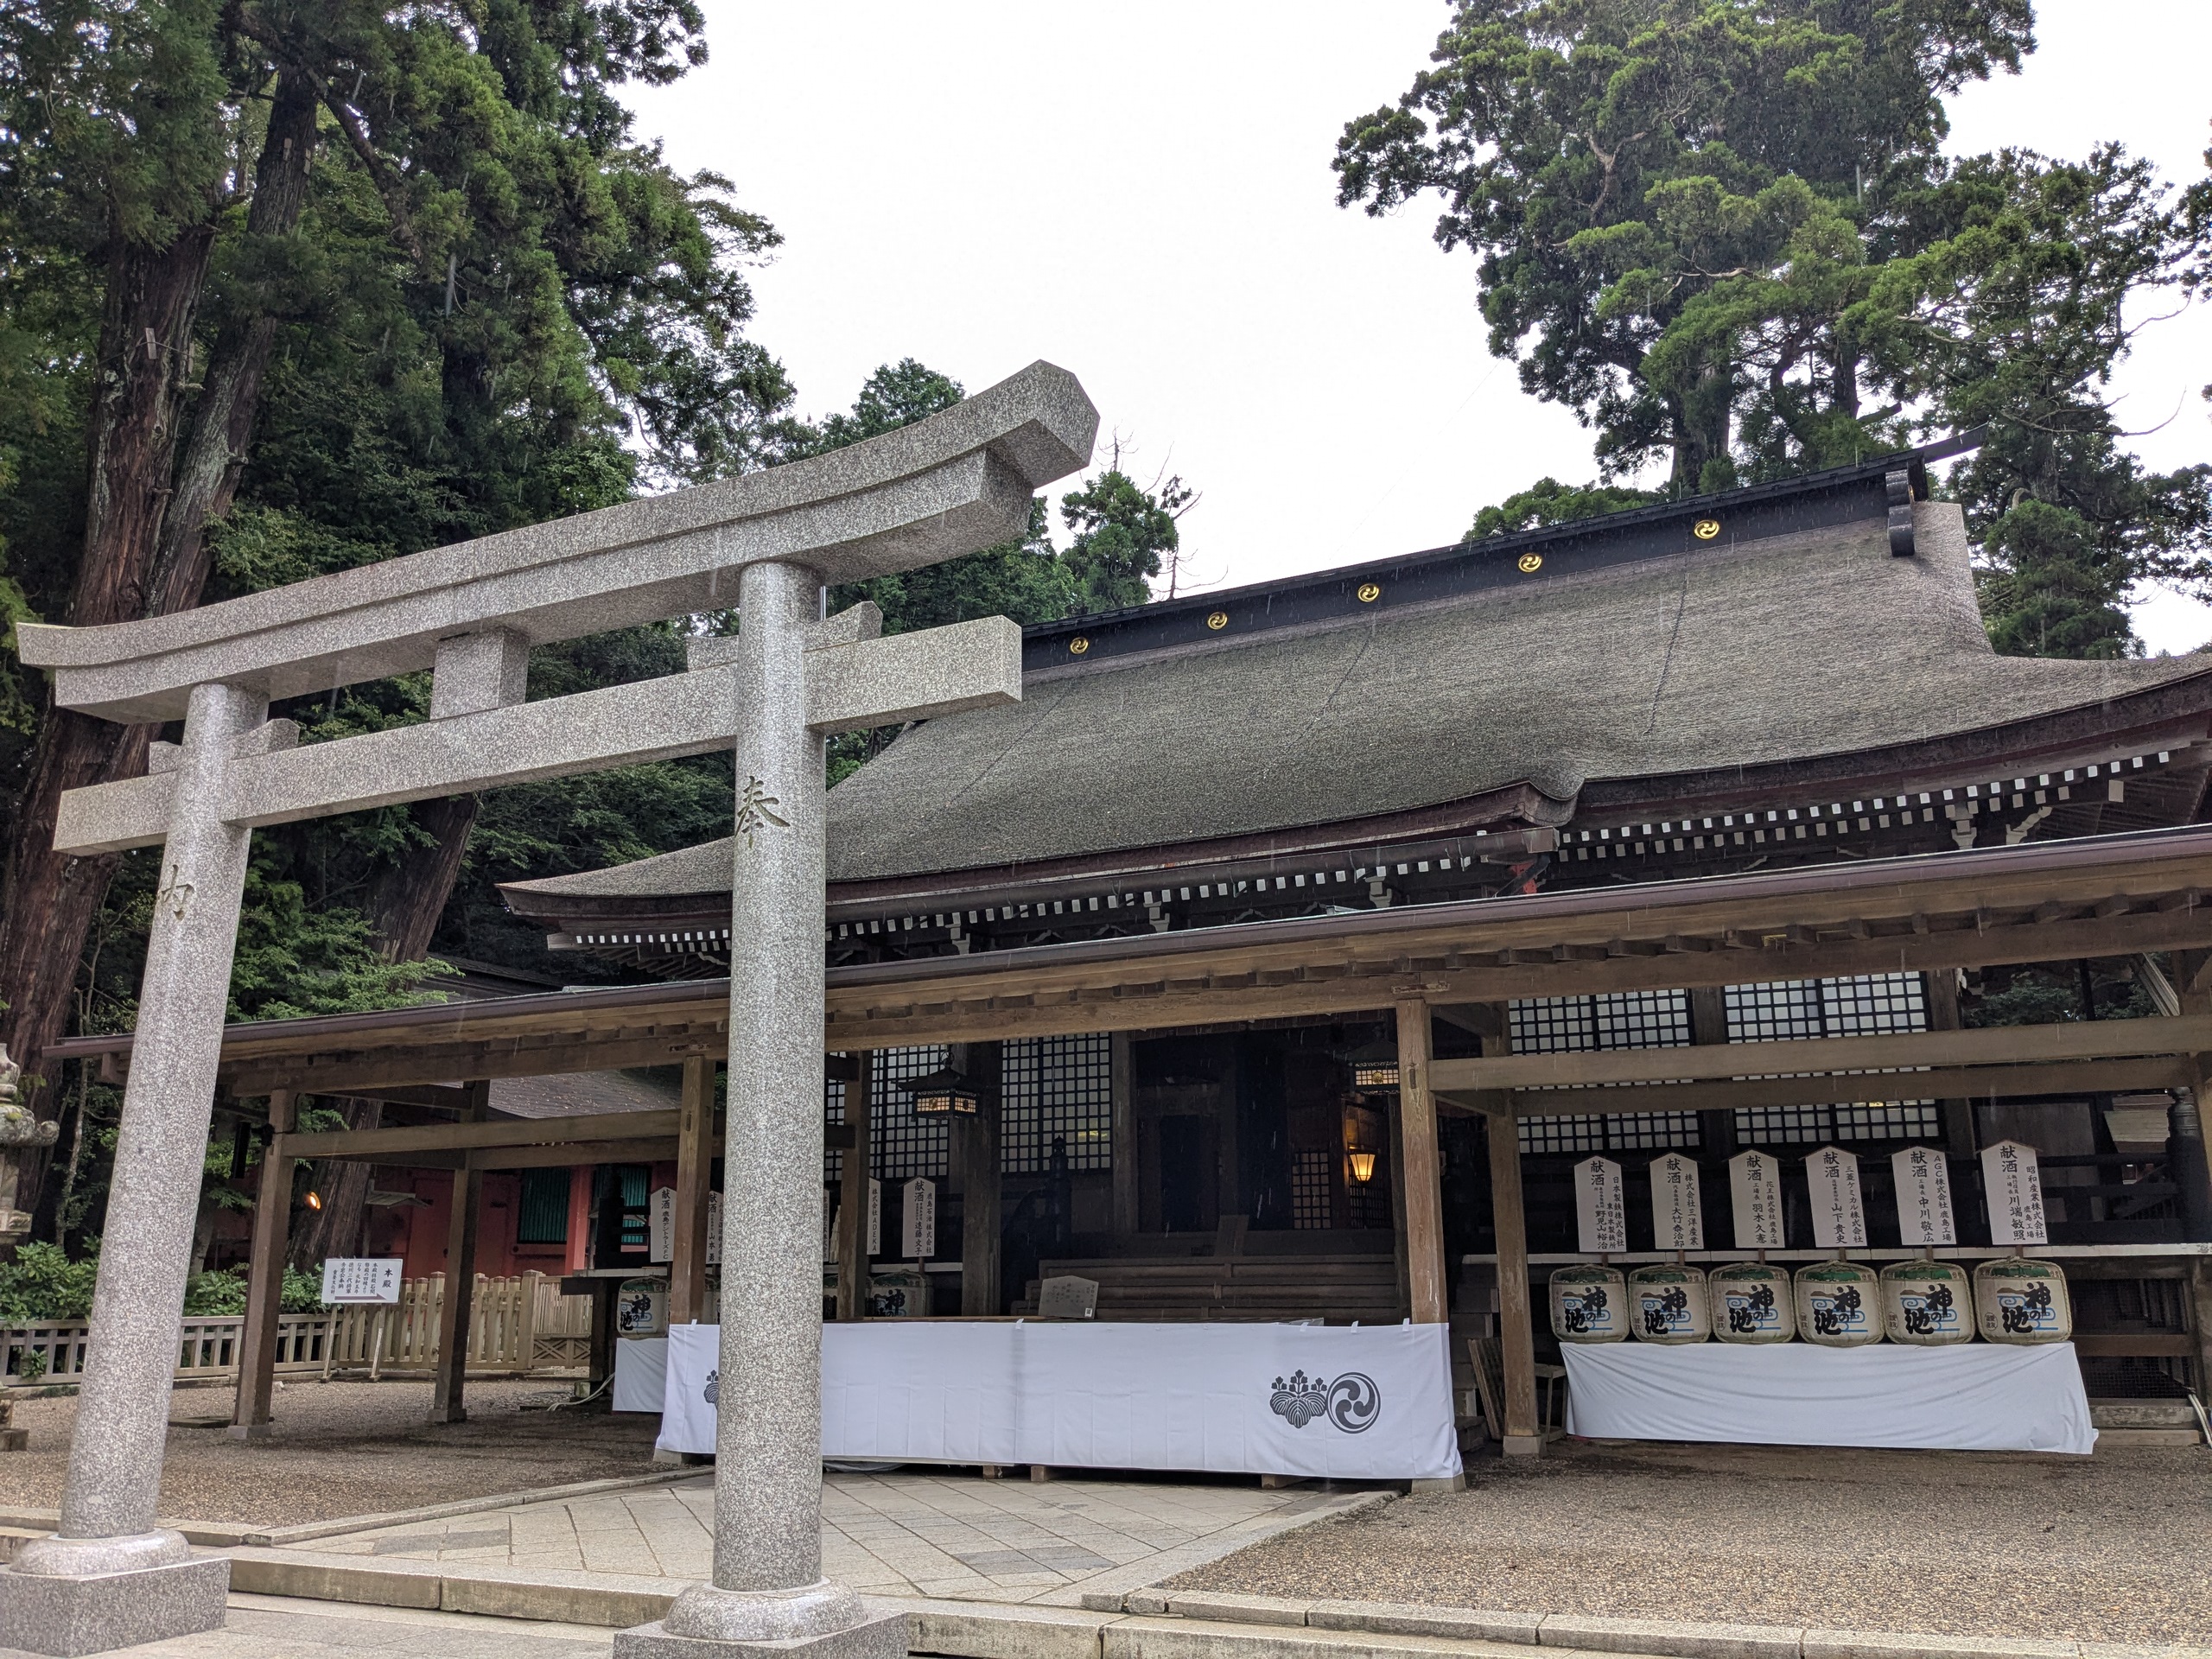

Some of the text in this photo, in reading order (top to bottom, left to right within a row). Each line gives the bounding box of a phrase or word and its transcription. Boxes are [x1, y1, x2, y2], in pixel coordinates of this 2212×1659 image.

[1590, 1160, 1605, 1186] 献酒
[1666, 1158, 1681, 1184] 献酒
[1746, 1154, 1763, 1181] 献酒
[1910, 1150, 1928, 1178] 献酒
[1999, 1145, 2018, 1173] 献酒
[661, 1189, 671, 1210] 献酒
[708, 1192, 718, 1213] 献酒
[914, 1180, 925, 1202] 献酒
[1766, 1180, 1777, 1220] 花王株式会社
[1822, 1151, 1840, 1178] 献酒
[1831, 1203, 1847, 1244] 山下貴史
[1845, 1166, 1864, 1243] 三菱ケミカル株式会社
[2025, 1166, 2046, 1239] 昭和産業株式会社
[1684, 1173, 1699, 1246] 株式会社三洋産業
[1918, 1197, 1935, 1243] 中川敬広
[381, 1268, 393, 1288] 本殿
